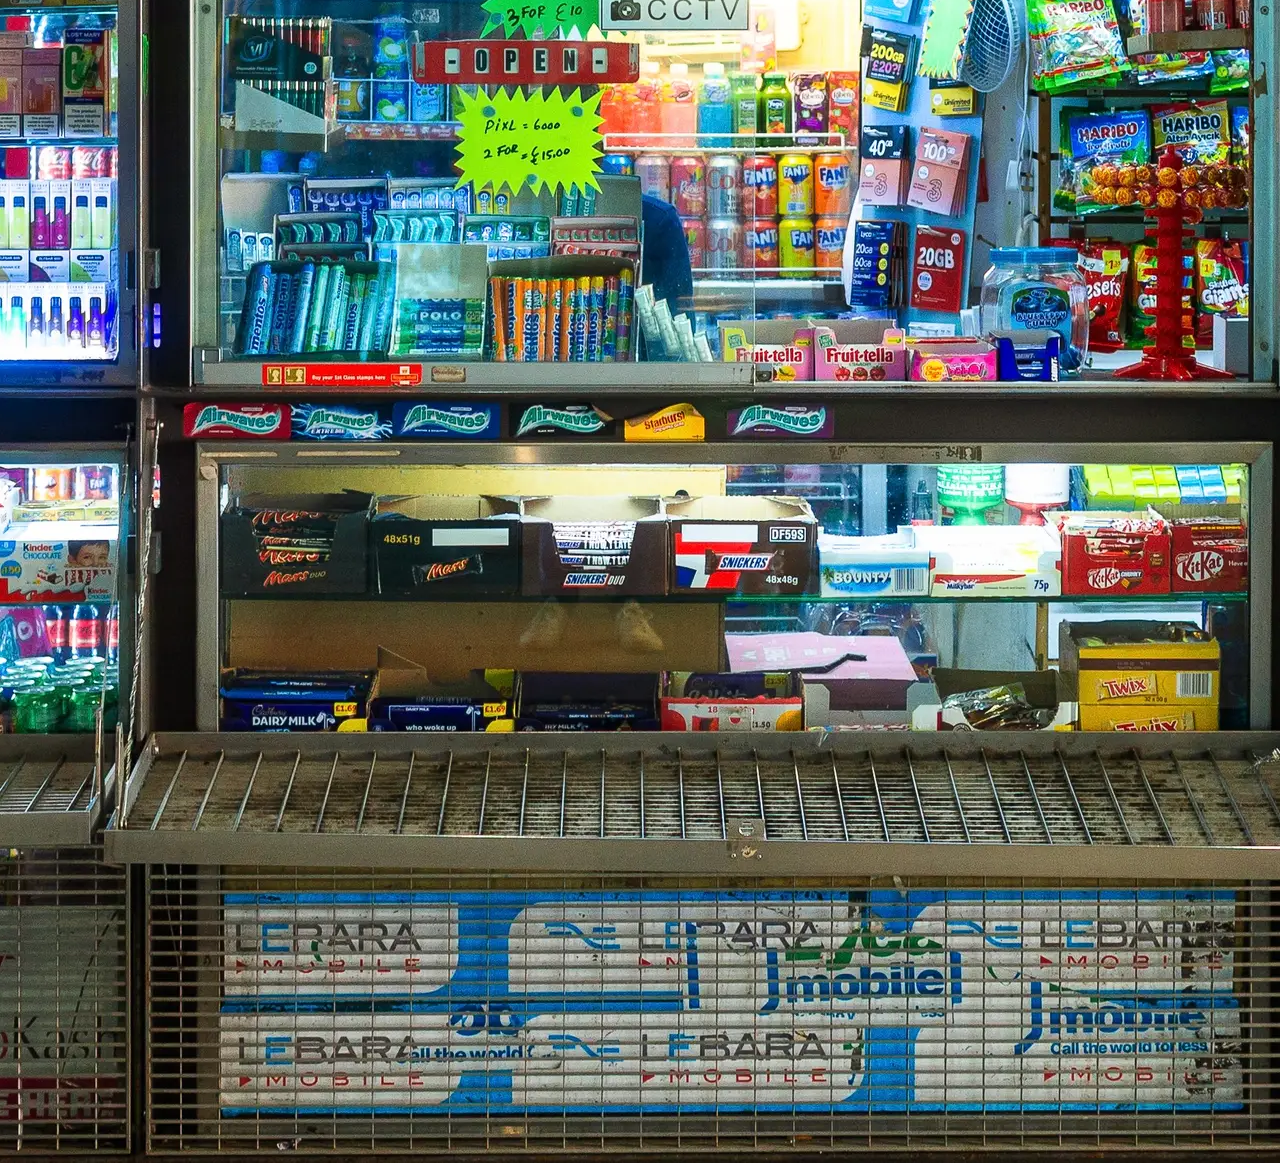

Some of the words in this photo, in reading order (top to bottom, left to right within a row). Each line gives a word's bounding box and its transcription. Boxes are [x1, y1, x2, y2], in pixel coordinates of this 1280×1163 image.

[521, 6, 545, 17] FOR
[870, 43, 905, 64] 200GB
[533, 122, 560, 131] 6000
[1162, 114, 1221, 131] HARIBO
[1078, 123, 1138, 141] HARIBO
[484, 148, 493, 159] 2
[497, 145, 519, 157] FOR
[918, 248, 954, 268] 20GB
[826, 348, 893, 363] Fruit-tella
[196, 406, 278, 428] Airwaves
[644, 411, 685, 430] Starburst
[384, 535, 420, 545] 48x51g
[771, 529, 804, 540] DF59S
[427, 559, 469, 580] Mars
[720, 557, 768, 568] SNICKERS
[1177, 552, 1223, 580] KitKat
[566, 574, 607, 585] SNICKERS
[608, 575, 626, 585] DUO
[766, 575, 798, 585] 48x48g
[834, 572, 891, 583] BOUNTY
[1034, 579, 1049, 591] 75p
[1104, 678, 1146, 695] Twix
[335, 705, 357, 713] £1.69
[252, 716, 286, 726] DAIRY
[288, 716, 317, 725] MILK
[238, 1036, 420, 1065] LEBARA
[1050, 1042, 1080, 1055] Call
[1083, 1042, 1106, 1055] the
[1109, 1042, 1152, 1055] world
[1154, 1042, 1176, 1054] for
[1178, 1041, 1208, 1053] less
[266, 1072, 425, 1086] MOBILE
